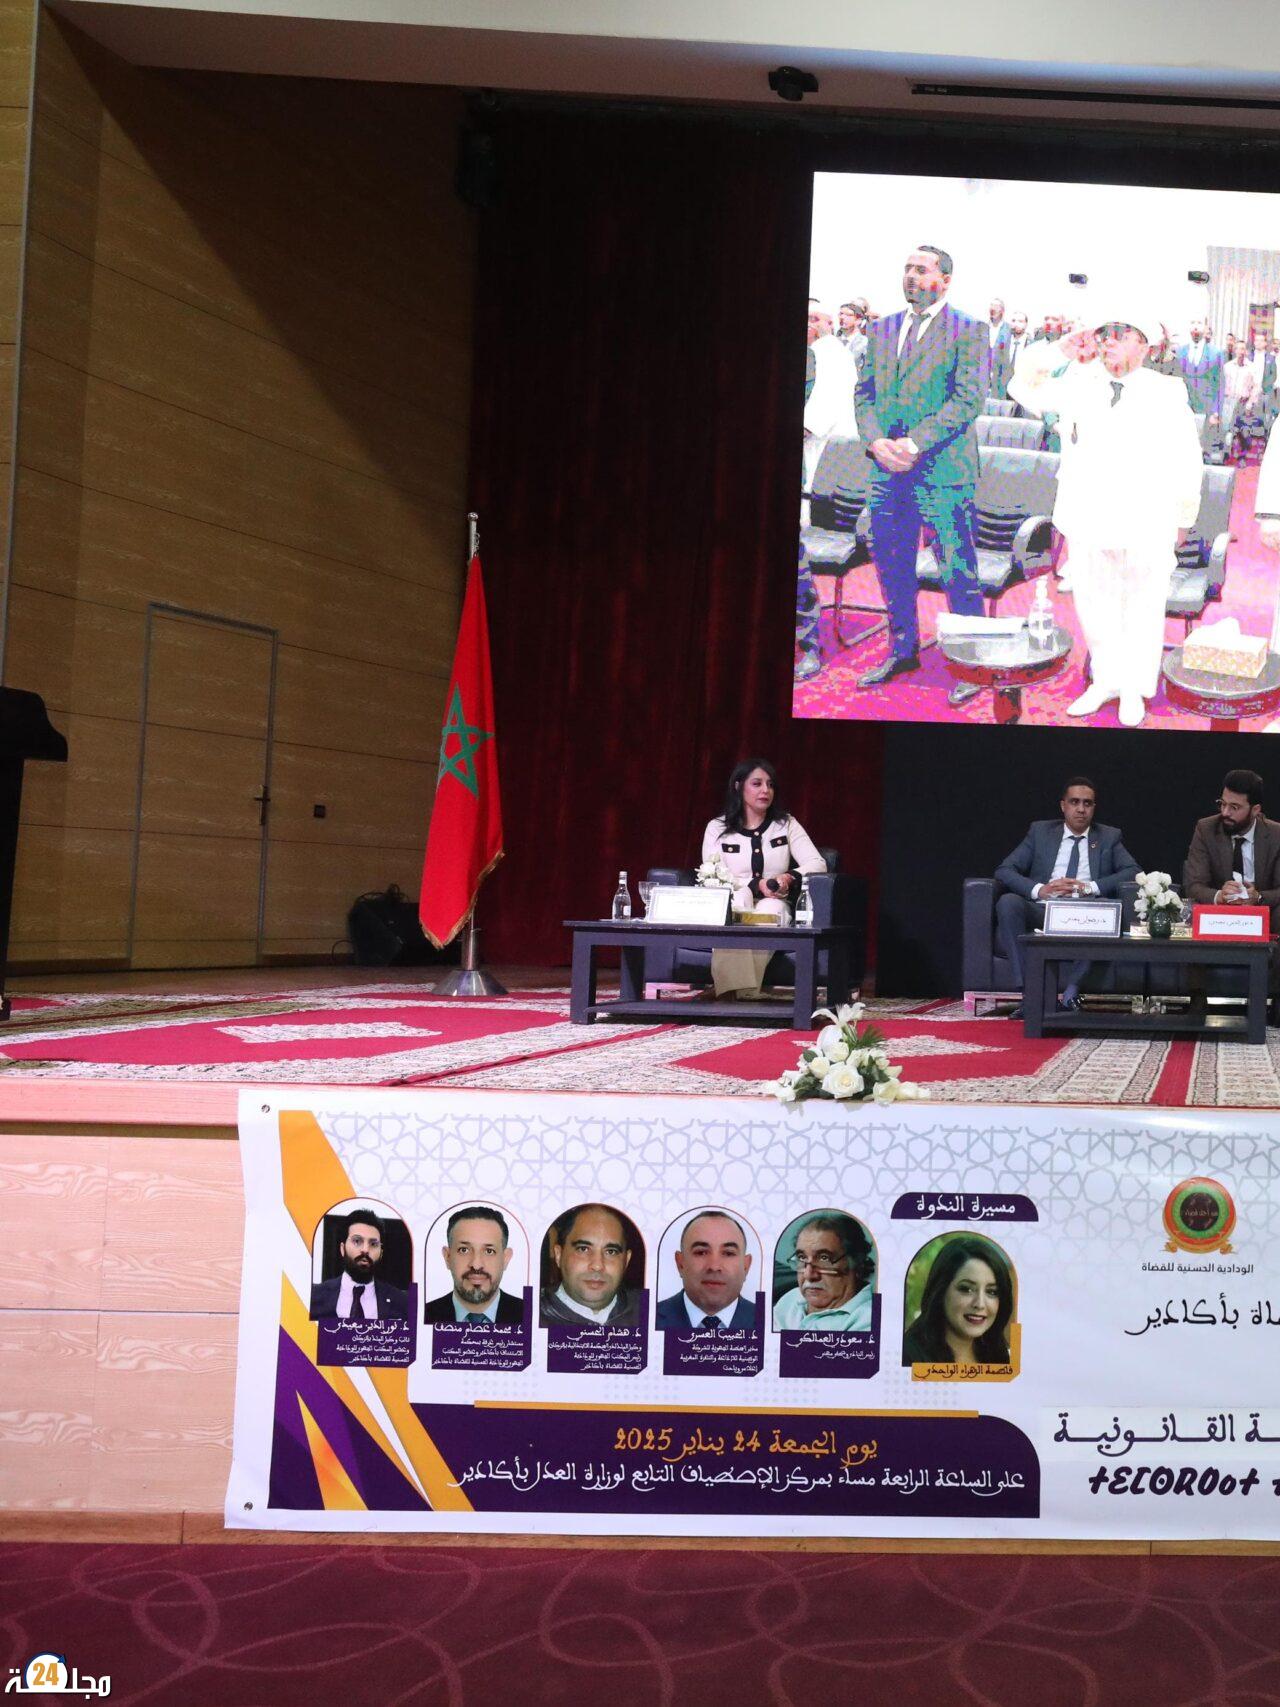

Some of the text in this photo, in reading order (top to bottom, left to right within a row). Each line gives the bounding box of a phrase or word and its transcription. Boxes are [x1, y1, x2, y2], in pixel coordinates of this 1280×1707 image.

[916, 1194, 1016, 1220] مسيرة الندوة
[1141, 1262, 1254, 1275] الودادية الحسنية للقضاة
[1124, 1292, 1240, 1336] بأكادير
[614, 1427, 878, 1470] يوم الجمعة 24 يناير 2025
[1054, 1412, 1235, 1457] القانونية
[447, 1456, 529, 1487] بأكادير
[511, 1461, 577, 1491] العدل
[581, 1464, 625, 1491] لوزارة
[631, 1464, 675, 1492] التابع
[771, 1467, 832, 1493] بمركز
[881, 1467, 929, 1495] الرابعة
[934, 1469, 992, 1489] الساعة
[971, 1470, 1025, 1497] على
